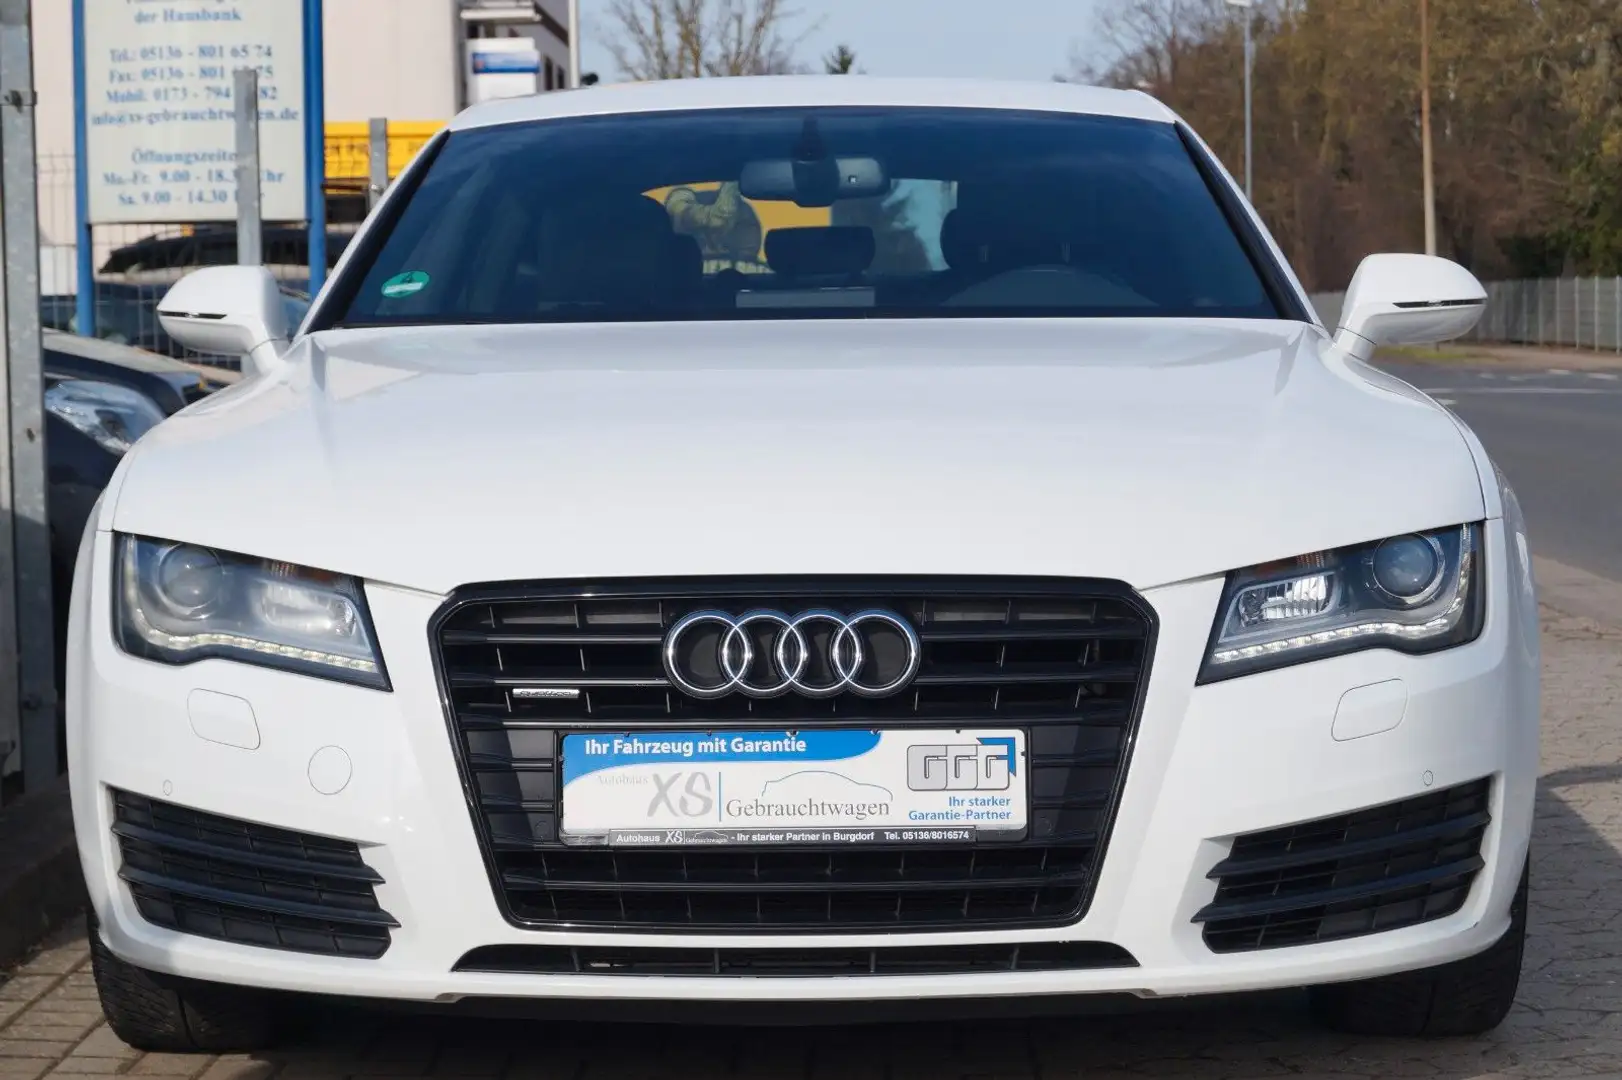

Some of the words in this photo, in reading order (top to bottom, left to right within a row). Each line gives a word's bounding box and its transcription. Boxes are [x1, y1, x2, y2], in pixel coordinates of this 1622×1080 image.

[163, 8, 242, 22] Hausbank
[198, 45, 223, 58] 801
[230, 44, 248, 58] 65
[254, 44, 272, 58] 74
[199, 65, 224, 79] 801
[585, 738, 610, 755] Ihr
[613, 738, 693, 757] Fahrzeug
[697, 737, 727, 753] mit
[730, 736, 807, 753] Garantie
[647, 771, 713, 817] XS
[726, 798, 890, 820] Gebrauchtwagen
[948, 796, 966, 807] Ihr
[968, 796, 1011, 807] starker
[908, 809, 1012, 821] Garantie-Partner
[616, 834, 661, 843] Autohaus
[665, 830, 683, 844] XS
[736, 832, 750, 841] Ihr
[751, 832, 784, 842] starker
[786, 831, 820, 841] Partner
[822, 831, 831, 841] in
[833, 831, 875, 842] Burgdorf
[884, 831, 900, 840] Tel.
[902, 830, 969, 840] 05136/8016574
